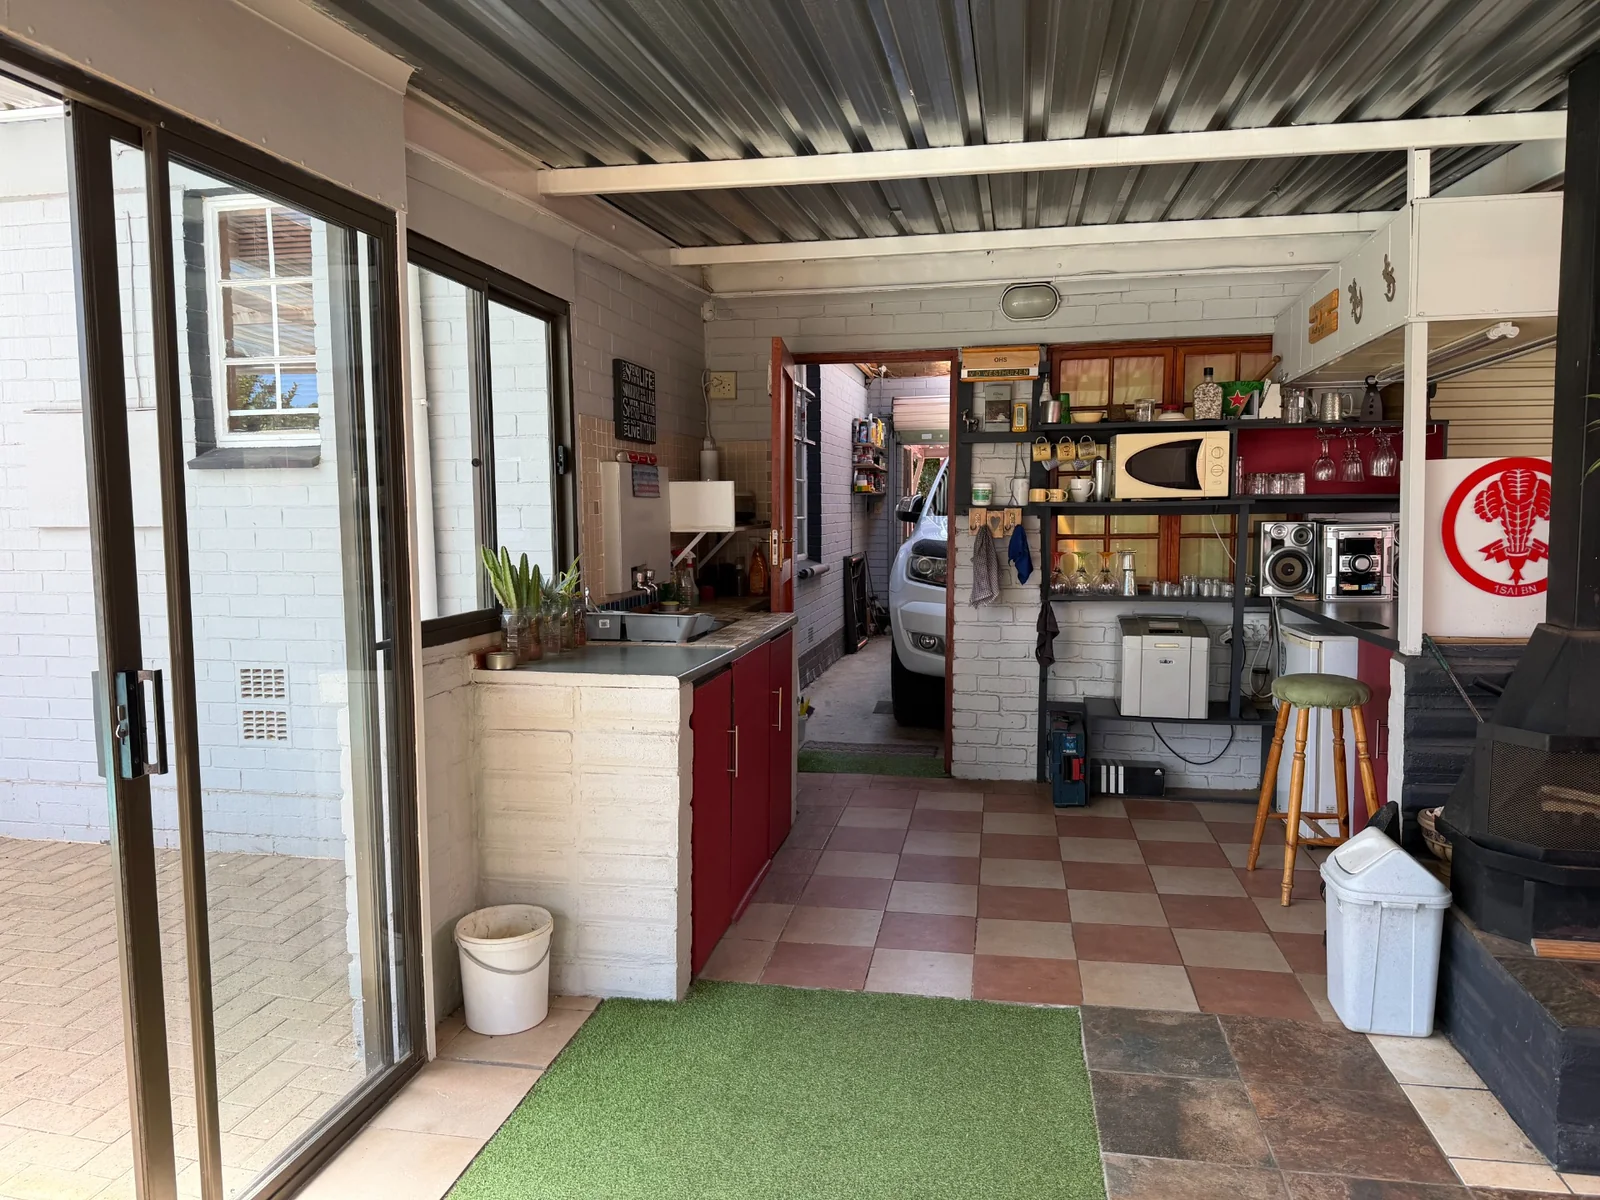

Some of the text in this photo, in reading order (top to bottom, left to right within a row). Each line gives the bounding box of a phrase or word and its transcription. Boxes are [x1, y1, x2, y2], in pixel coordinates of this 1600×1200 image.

[640, 368, 654, 389] LIFE
[628, 425, 640, 438] LIVE
[1521, 585, 1538, 595] BN
